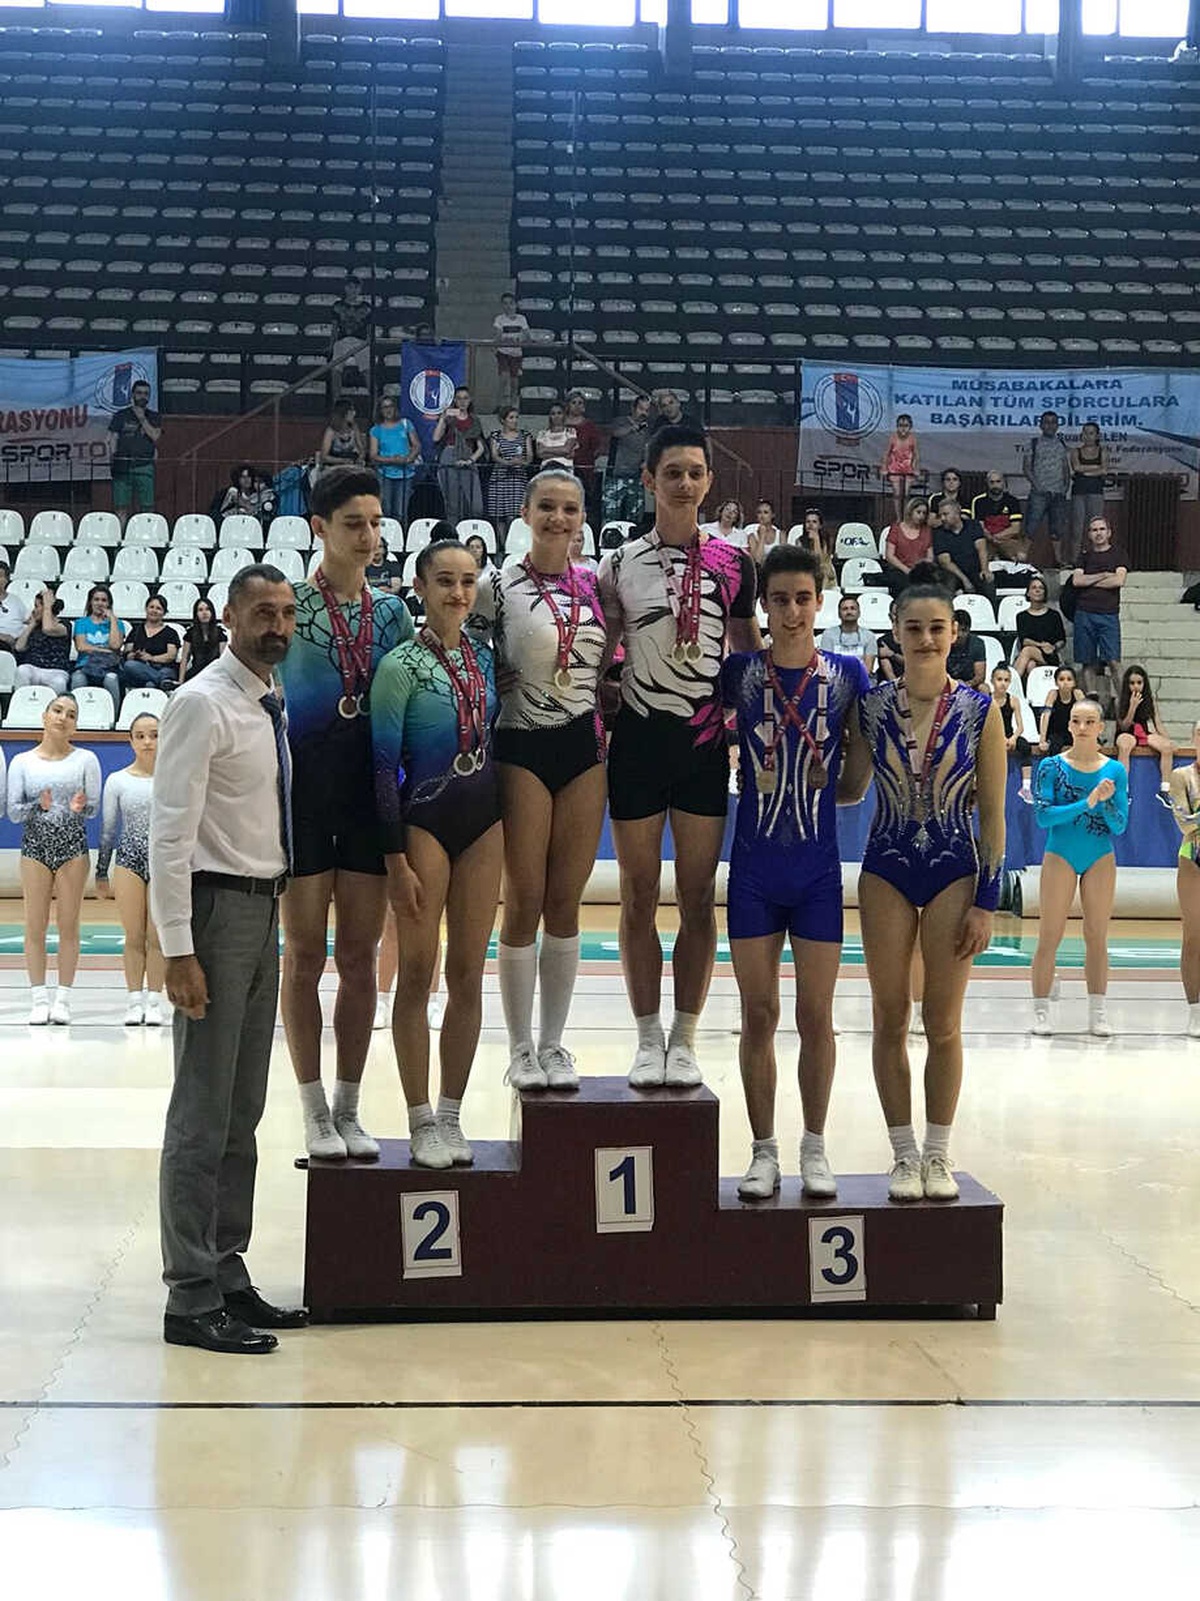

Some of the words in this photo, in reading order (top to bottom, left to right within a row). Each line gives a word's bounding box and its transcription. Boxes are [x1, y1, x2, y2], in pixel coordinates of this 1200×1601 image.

[894, 393, 983, 408] KATILAN
[990, 394, 1035, 408] TÜM
[1041, 395, 1180, 409] SPORCULARA
[609, 1156, 636, 1214] 1
[413, 1201, 453, 1261] 2
[821, 1226, 859, 1285] 3
